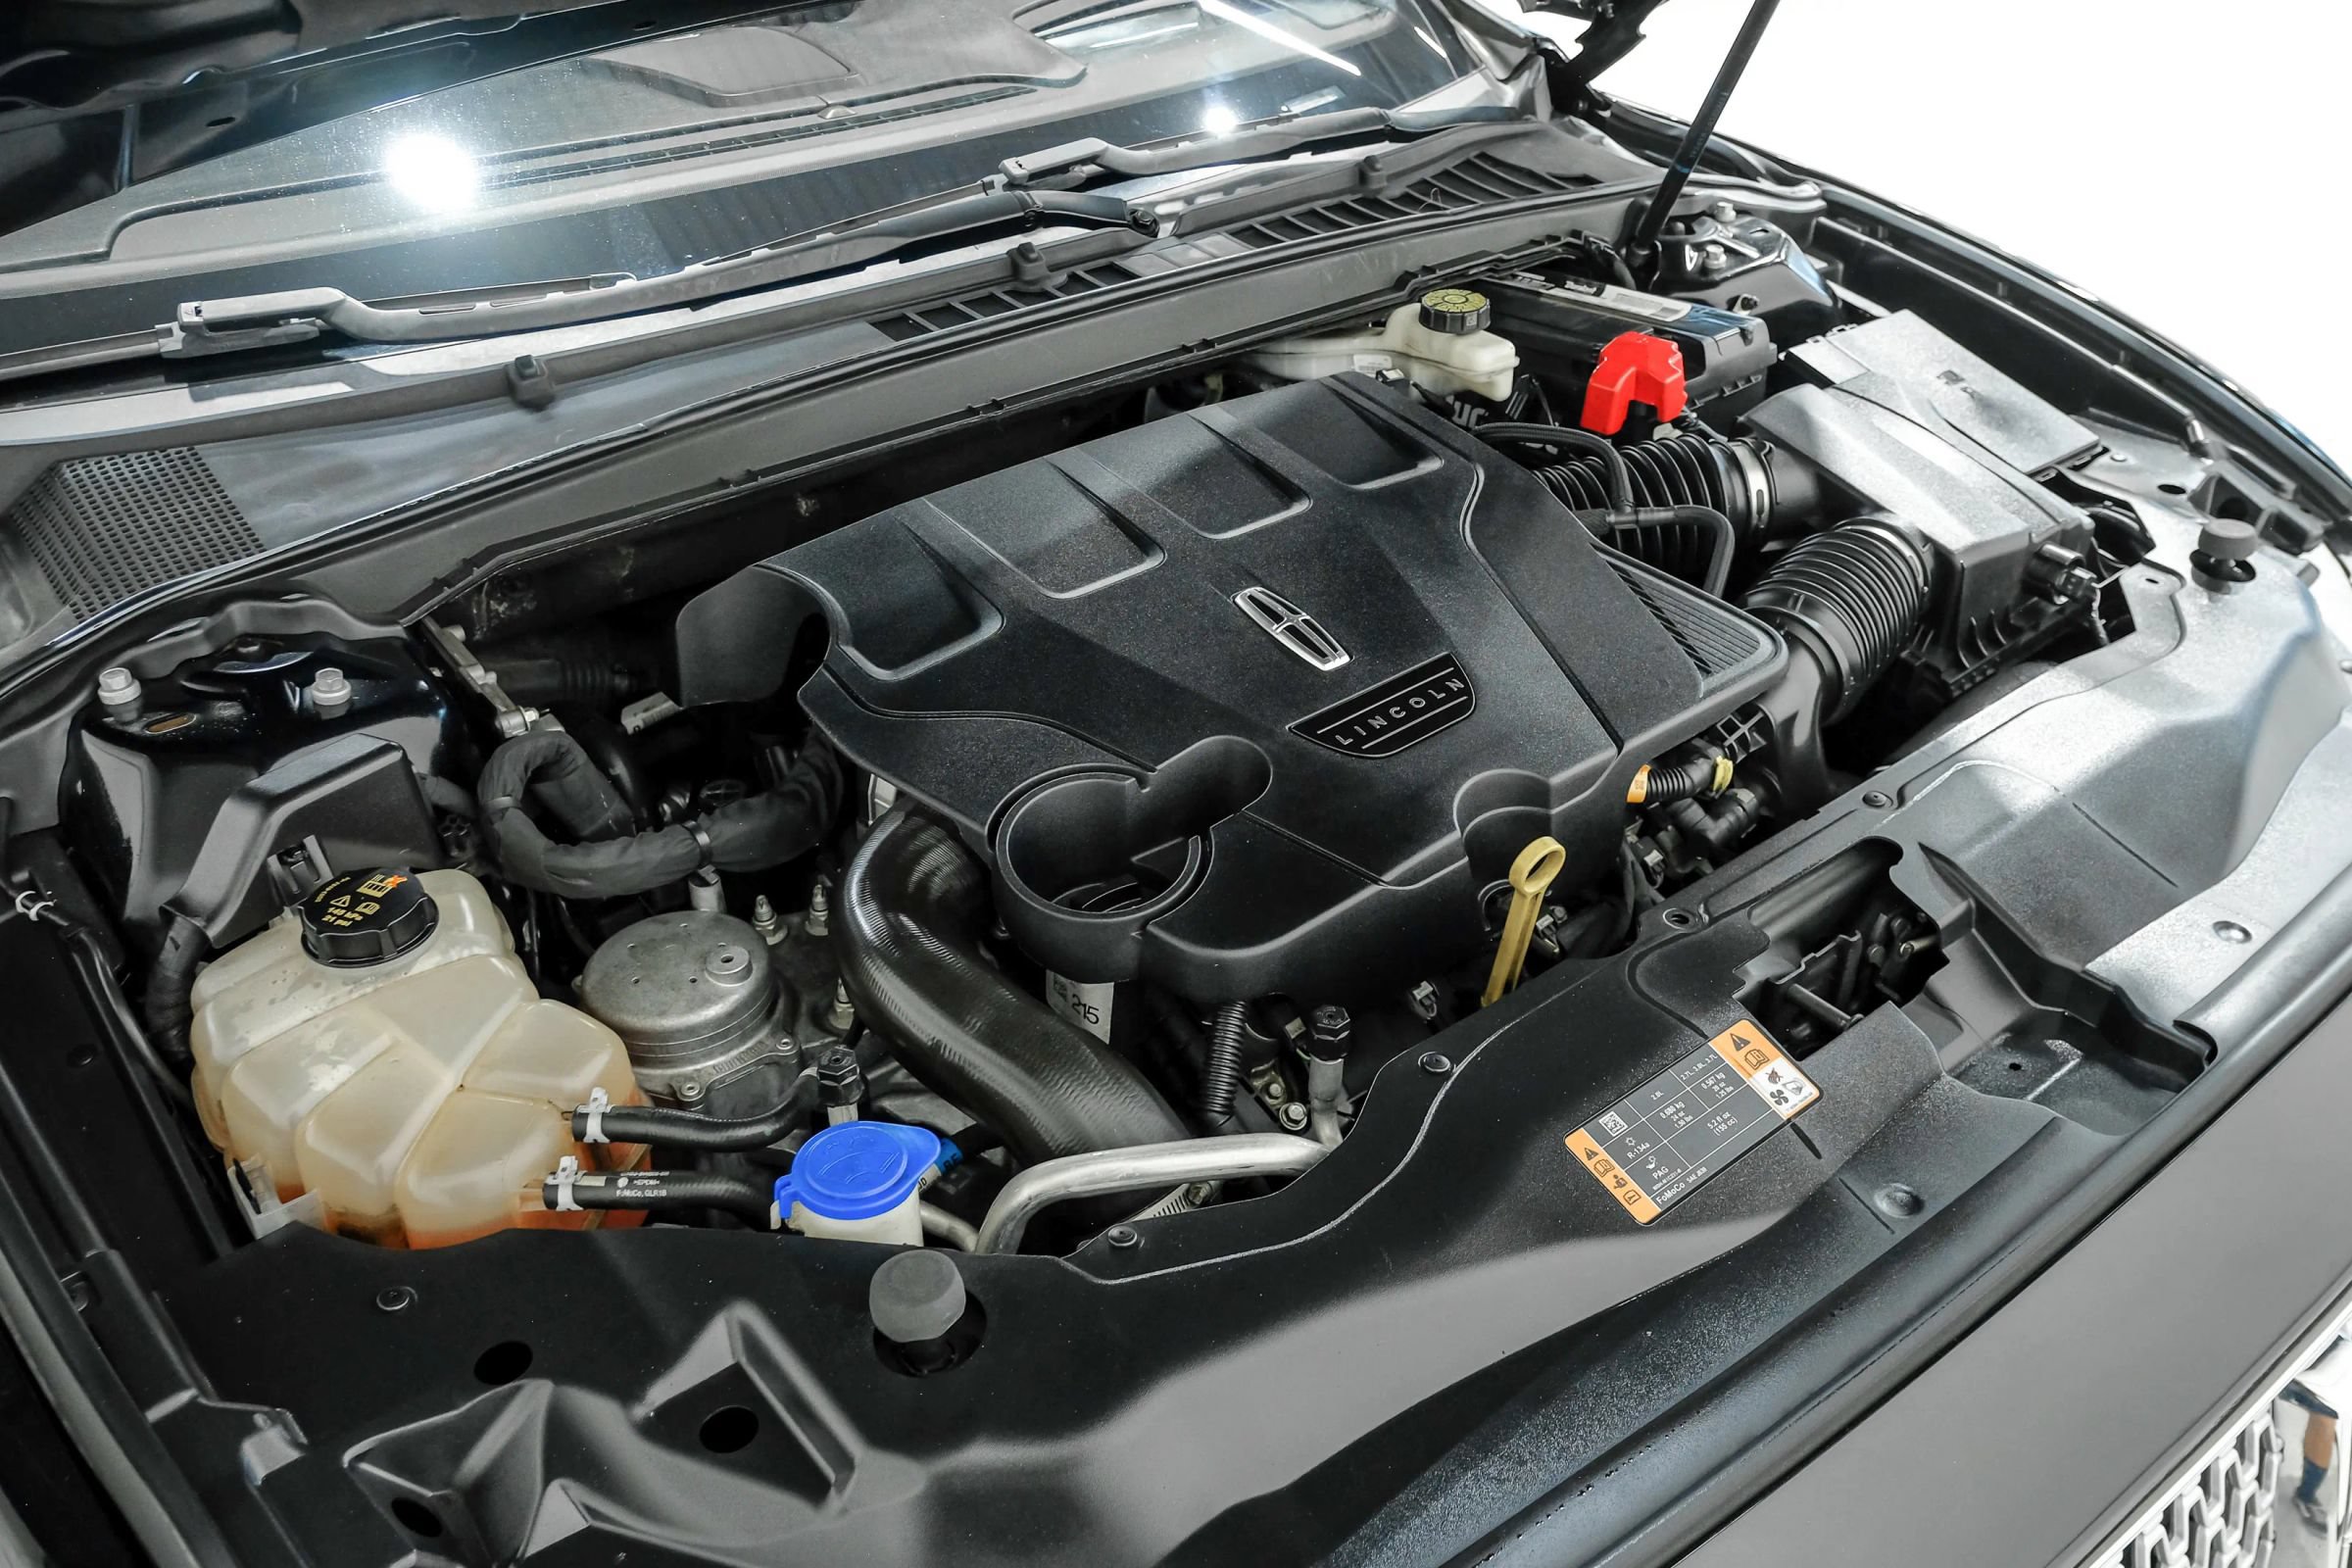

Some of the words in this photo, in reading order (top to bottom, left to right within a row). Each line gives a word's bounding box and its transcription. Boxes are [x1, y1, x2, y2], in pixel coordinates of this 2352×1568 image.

[1335, 678, 1465, 746] LINCOLN
[1071, 993, 1100, 1025] 215
[1673, 1101, 1686, 1109] kg
[1707, 1119, 1719, 1130] 5.2
[1713, 1122, 1728, 1137] (155
[1626, 1142, 1650, 1159] R-134a
[1651, 1165, 1669, 1180] PAG
[1655, 1182, 1686, 1204] FoMoCo
[1686, 1173, 1698, 1184] SAE
